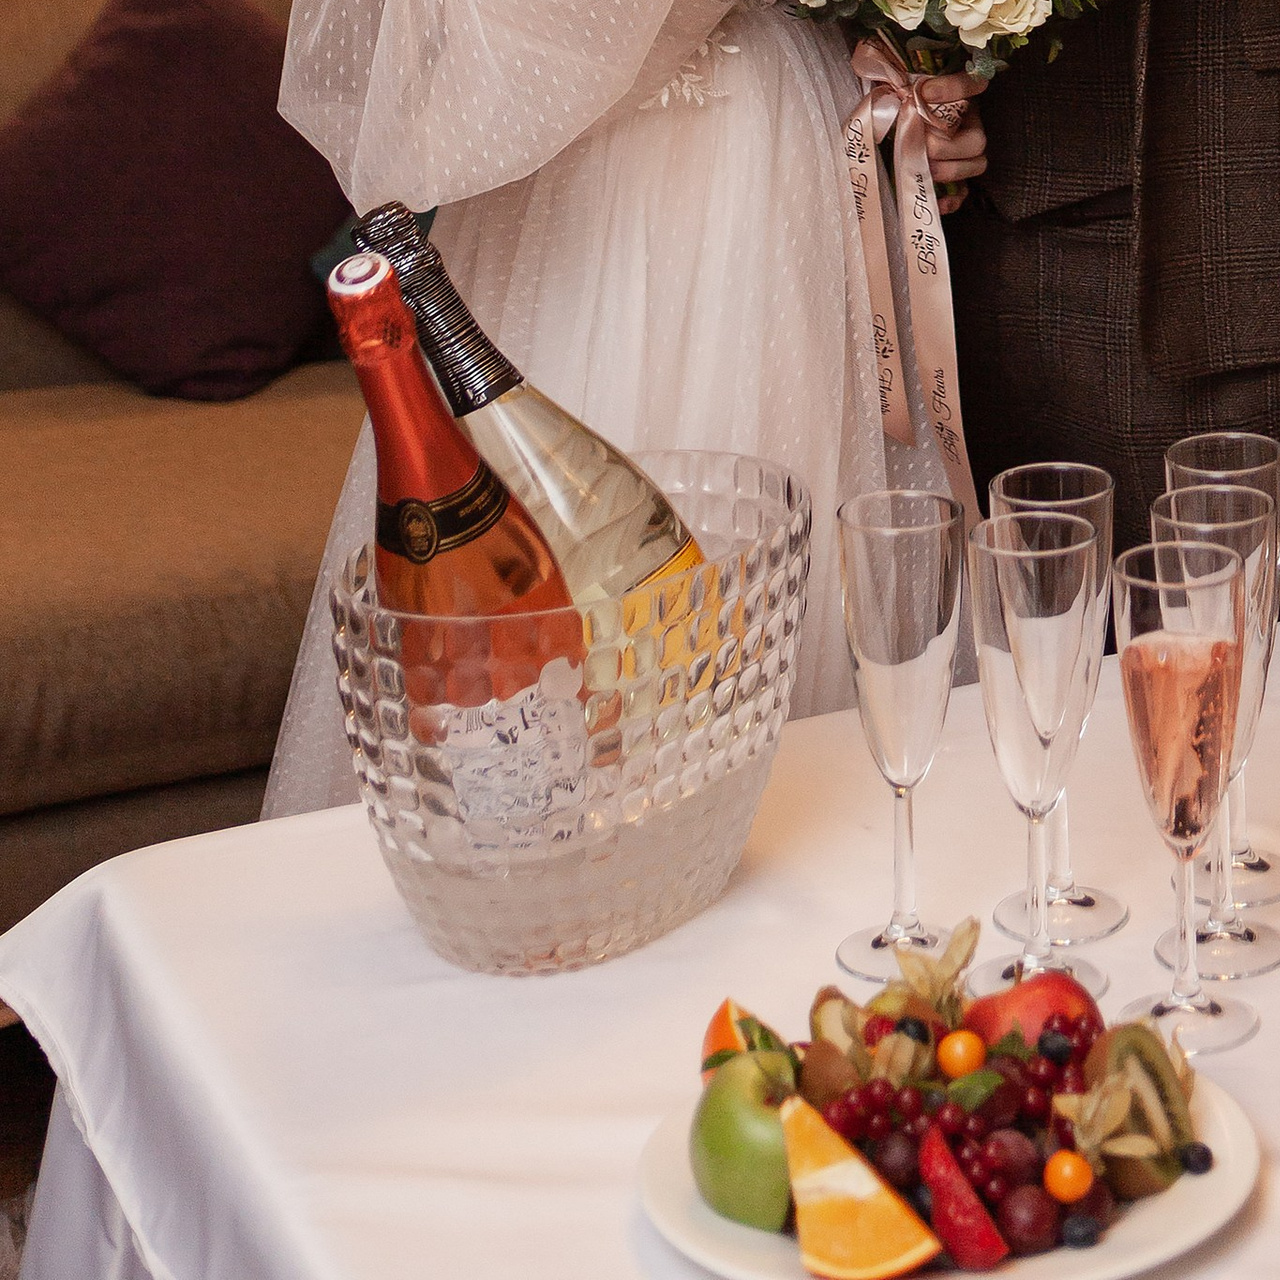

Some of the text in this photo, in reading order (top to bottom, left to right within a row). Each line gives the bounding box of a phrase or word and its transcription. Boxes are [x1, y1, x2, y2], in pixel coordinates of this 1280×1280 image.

[843, 118, 864, 161] Bay
[914, 171, 940, 275] Bay Fleurs
[932, 367, 952, 421] Fleurs
